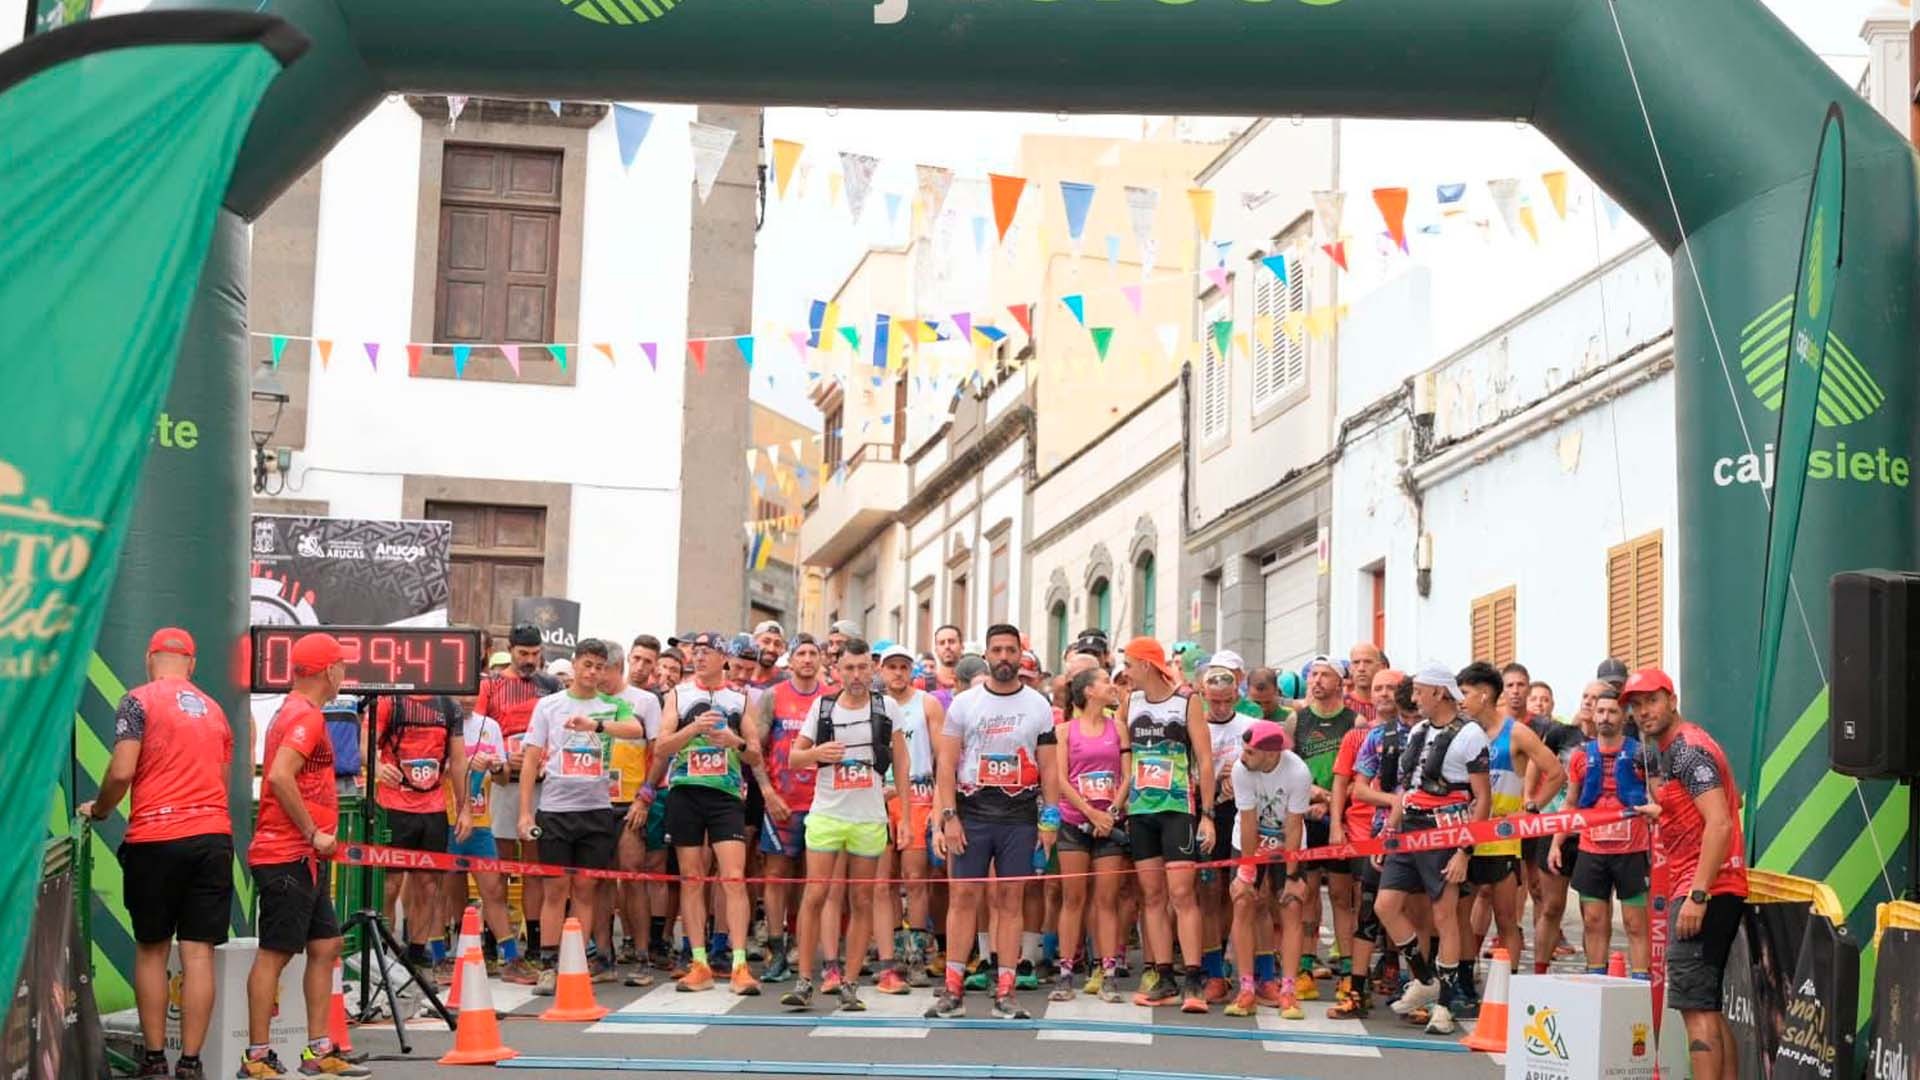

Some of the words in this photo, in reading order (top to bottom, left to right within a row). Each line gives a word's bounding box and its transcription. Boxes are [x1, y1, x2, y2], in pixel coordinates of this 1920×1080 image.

[1713, 442, 1910, 489] cajsiete
[327, 549, 364, 559] ARUCAS
[573, 754, 592, 767] 70
[692, 754, 721, 769] 128
[839, 766, 868, 781] 154
[988, 761, 1009, 776] 98
[1144, 765, 1161, 778] 72
[1519, 813, 1587, 836] META
[1259, 834, 1278, 849] 79
[1406, 828, 1475, 849] META
[368, 848, 435, 868] META
[477, 859, 545, 875] META
[1651, 920, 1667, 988] META
